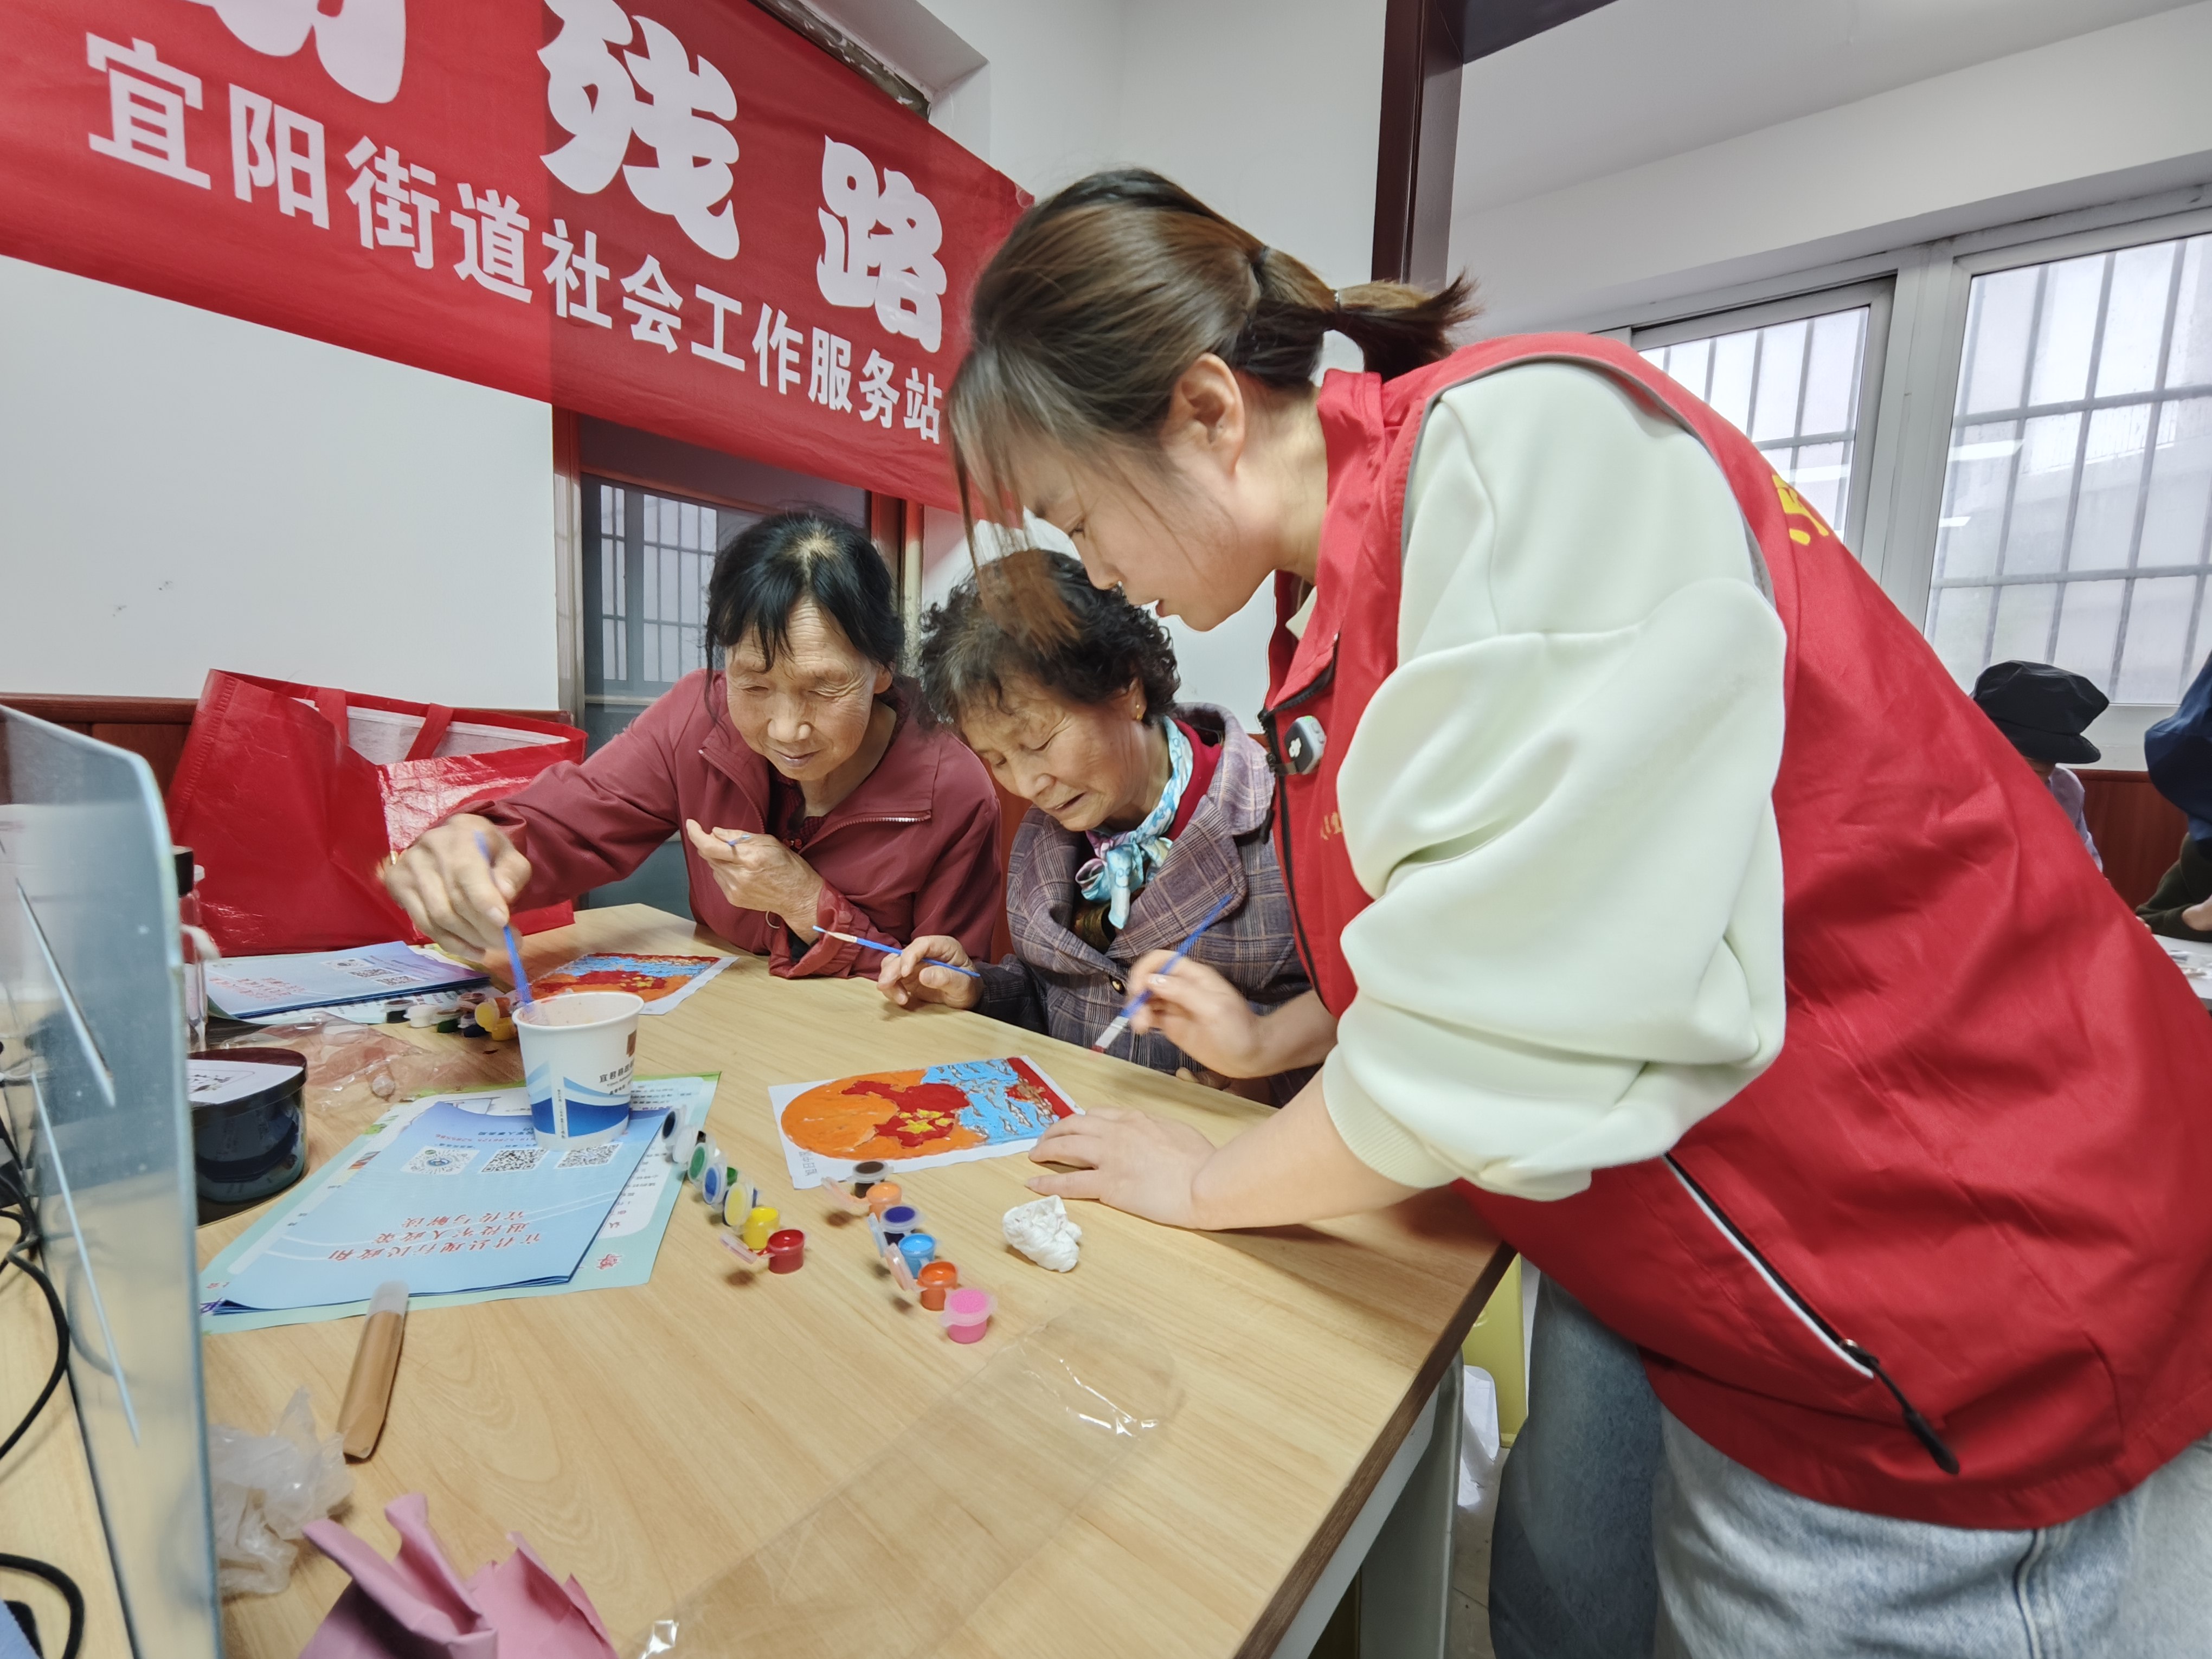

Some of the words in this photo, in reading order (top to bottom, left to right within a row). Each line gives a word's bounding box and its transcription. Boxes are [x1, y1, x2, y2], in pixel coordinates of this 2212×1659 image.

[86, 31, 942, 445] 宜阳街道社会工作服务站
